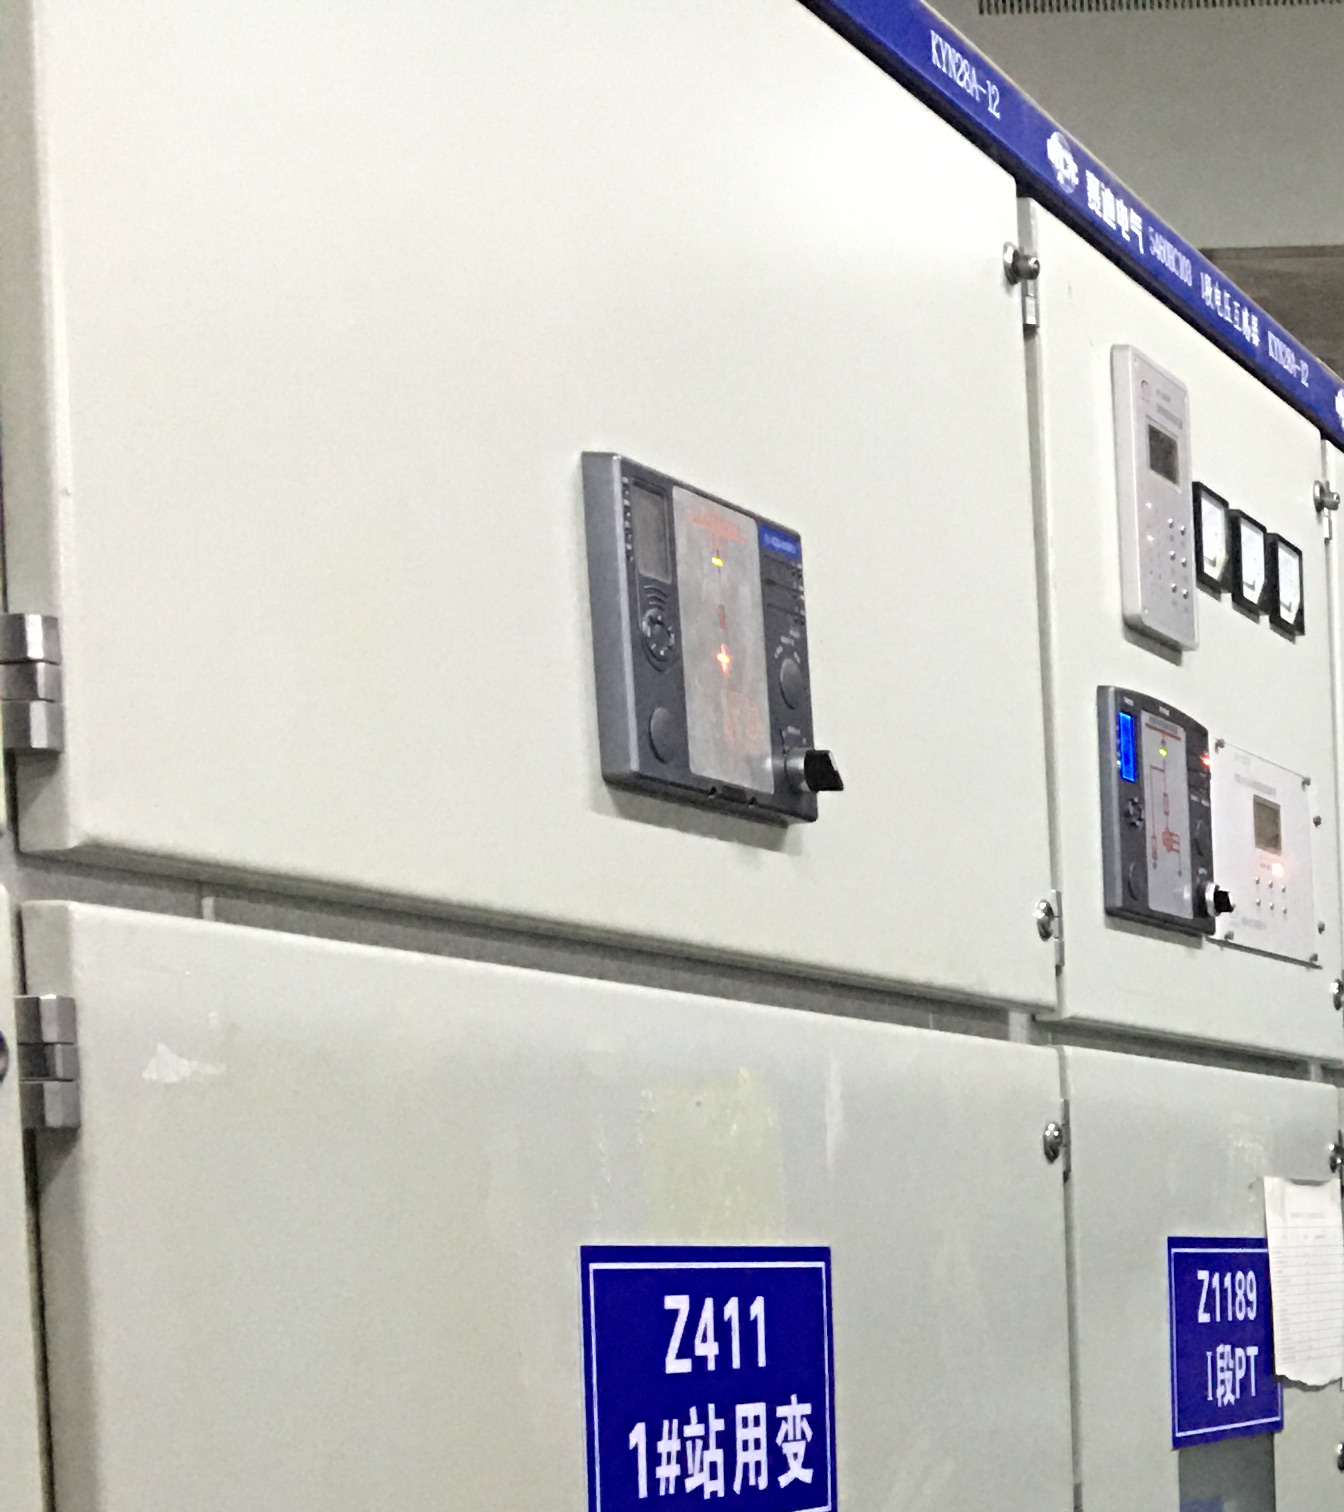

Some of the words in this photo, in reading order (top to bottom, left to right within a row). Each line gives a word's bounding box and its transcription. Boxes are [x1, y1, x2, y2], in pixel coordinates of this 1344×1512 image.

[930, 29, 1001, 119] KYN28A-12
[664, 1294, 766, 1374] Z411
[1197, 1269, 1258, 1324] Z1189
[629, 1393, 814, 1500] 1#站用变
